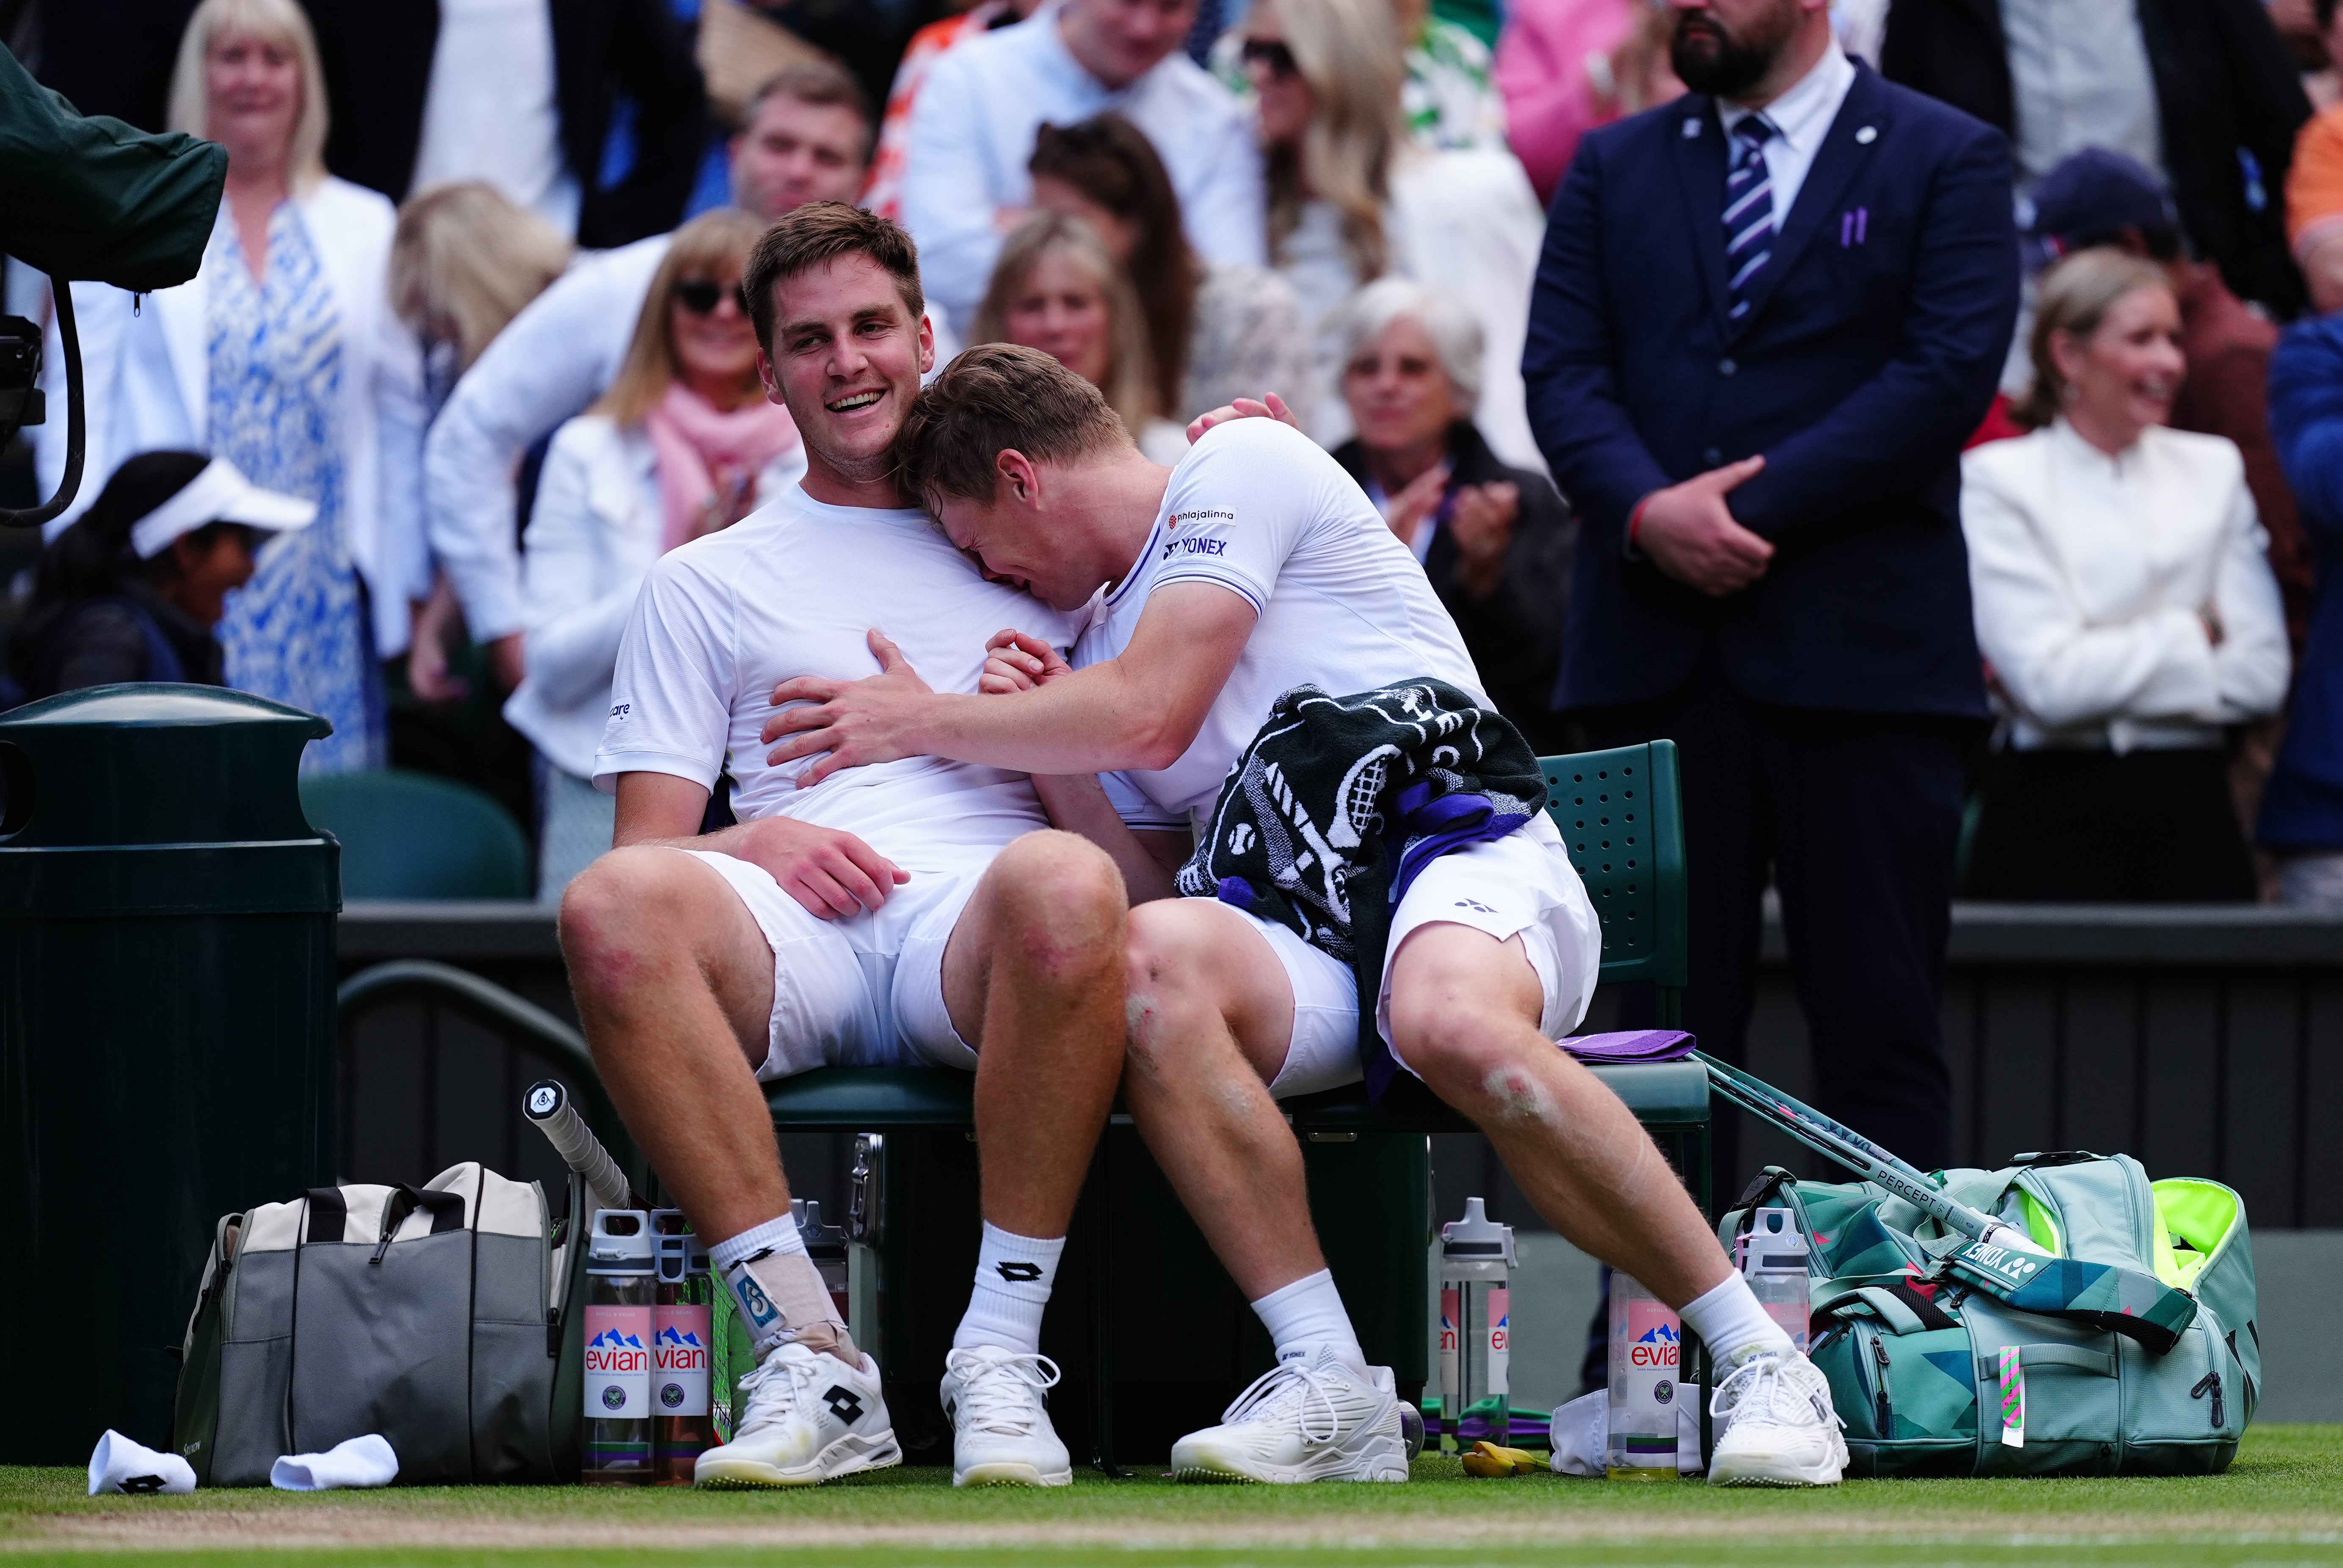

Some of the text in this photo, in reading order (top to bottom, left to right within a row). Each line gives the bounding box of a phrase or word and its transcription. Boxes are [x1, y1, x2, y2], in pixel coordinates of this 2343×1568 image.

[1181, 537, 1227, 556] YONEX
[1705, 1057, 1736, 1075] ISOMETRIC
[1877, 1170, 1936, 1208] PERCEPT
[1937, 1204, 1946, 1213] 97
[1961, 1242, 2010, 1270] YONEX
[586, 1347, 648, 1371] evian
